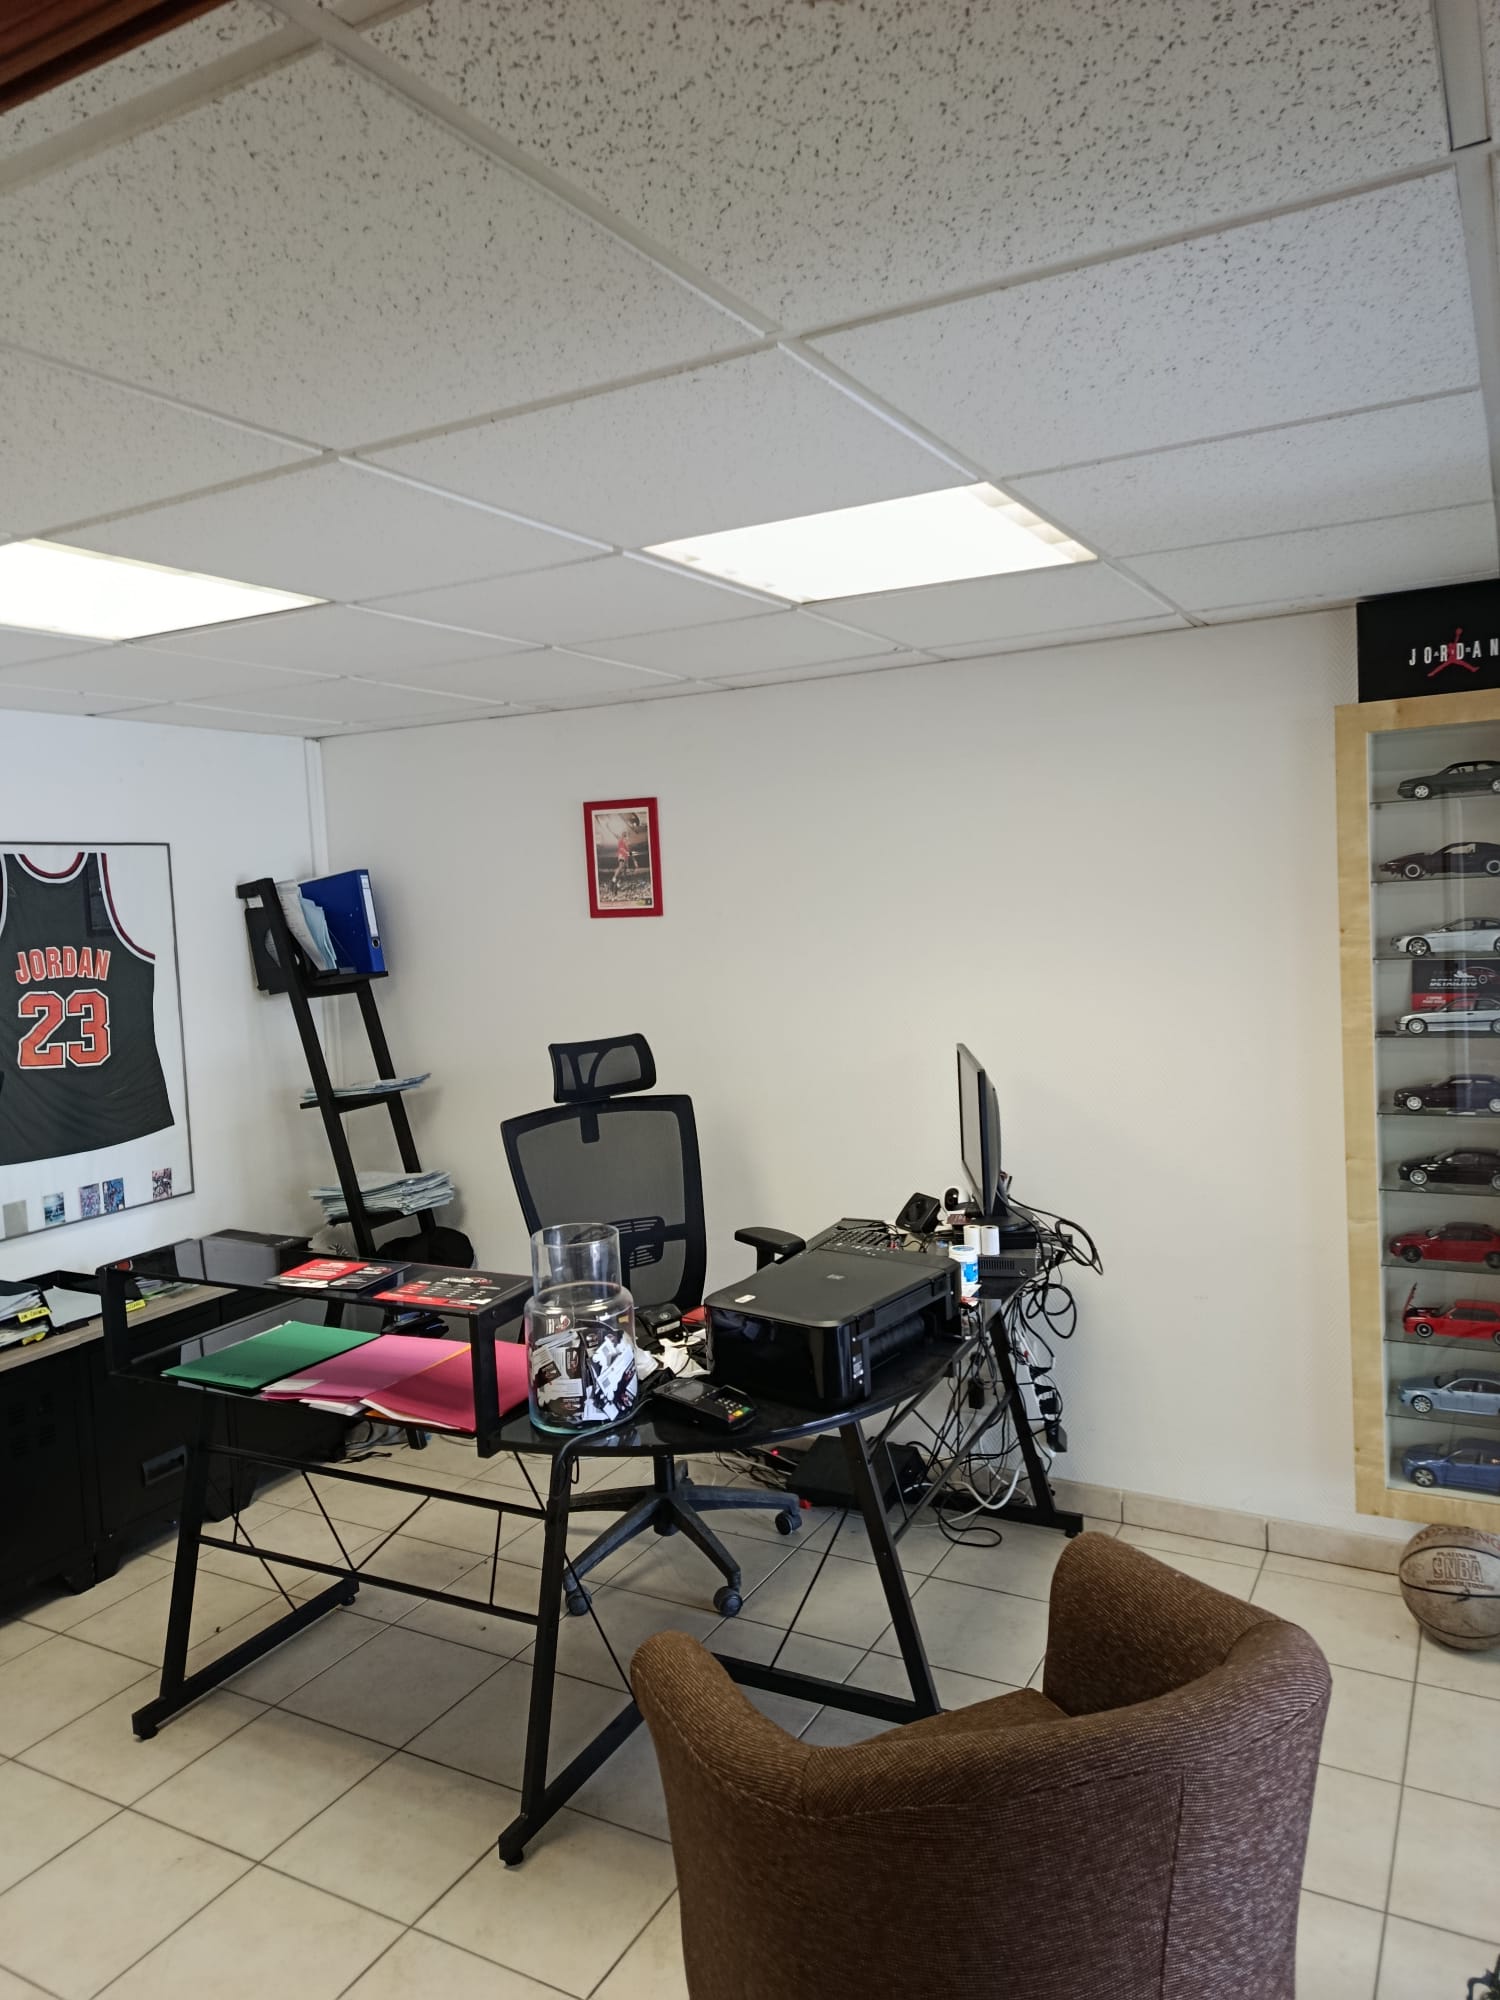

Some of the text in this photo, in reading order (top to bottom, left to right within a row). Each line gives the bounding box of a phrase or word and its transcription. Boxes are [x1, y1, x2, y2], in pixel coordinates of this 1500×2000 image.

[1408, 638, 1499, 666] JORDAN
[15, 945, 112, 985] JORDAN
[17, 988, 112, 1070] 23
[1443, 1557, 1484, 1583] NBA
